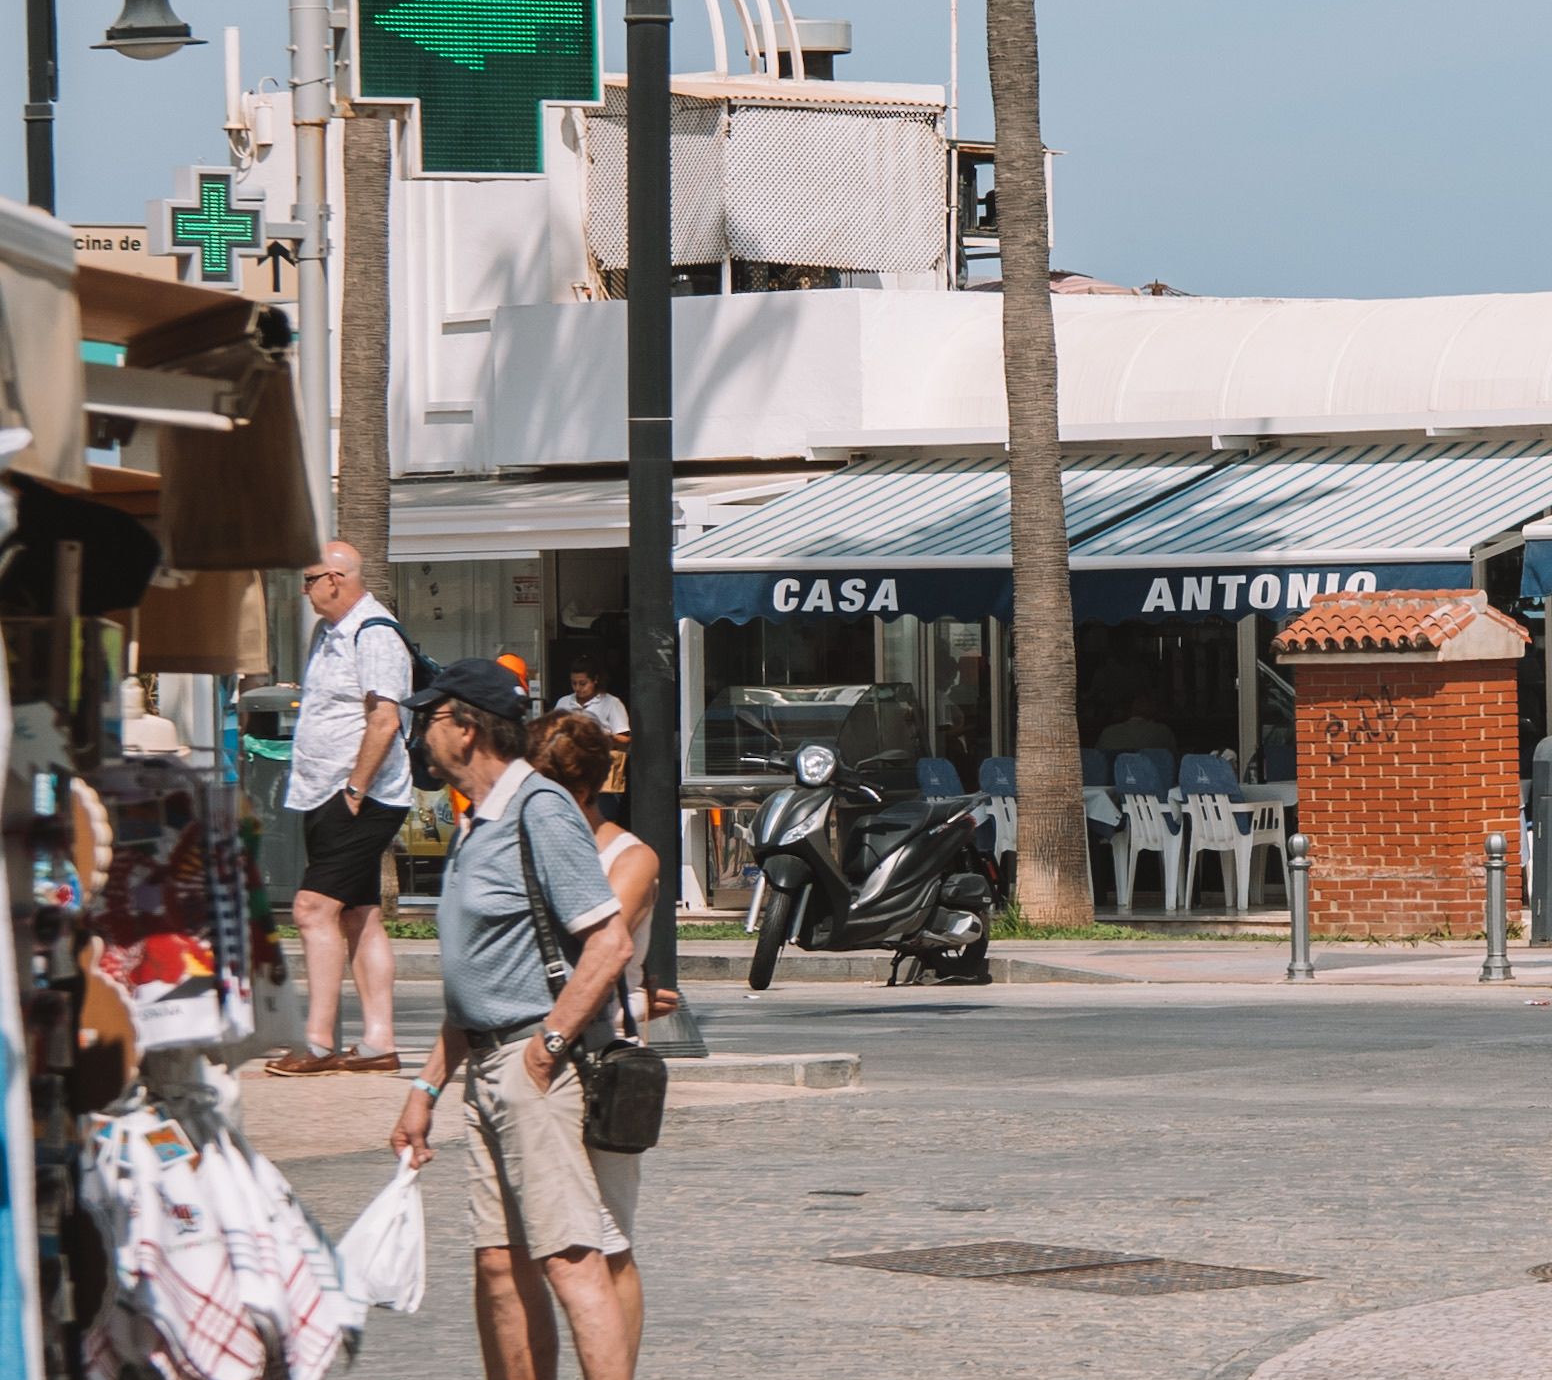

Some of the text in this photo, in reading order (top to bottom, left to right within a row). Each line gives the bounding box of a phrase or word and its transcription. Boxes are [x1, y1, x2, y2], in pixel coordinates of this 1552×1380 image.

[120, 234, 142, 252] de
[773, 571, 1377, 613] CASA ANTONIO
